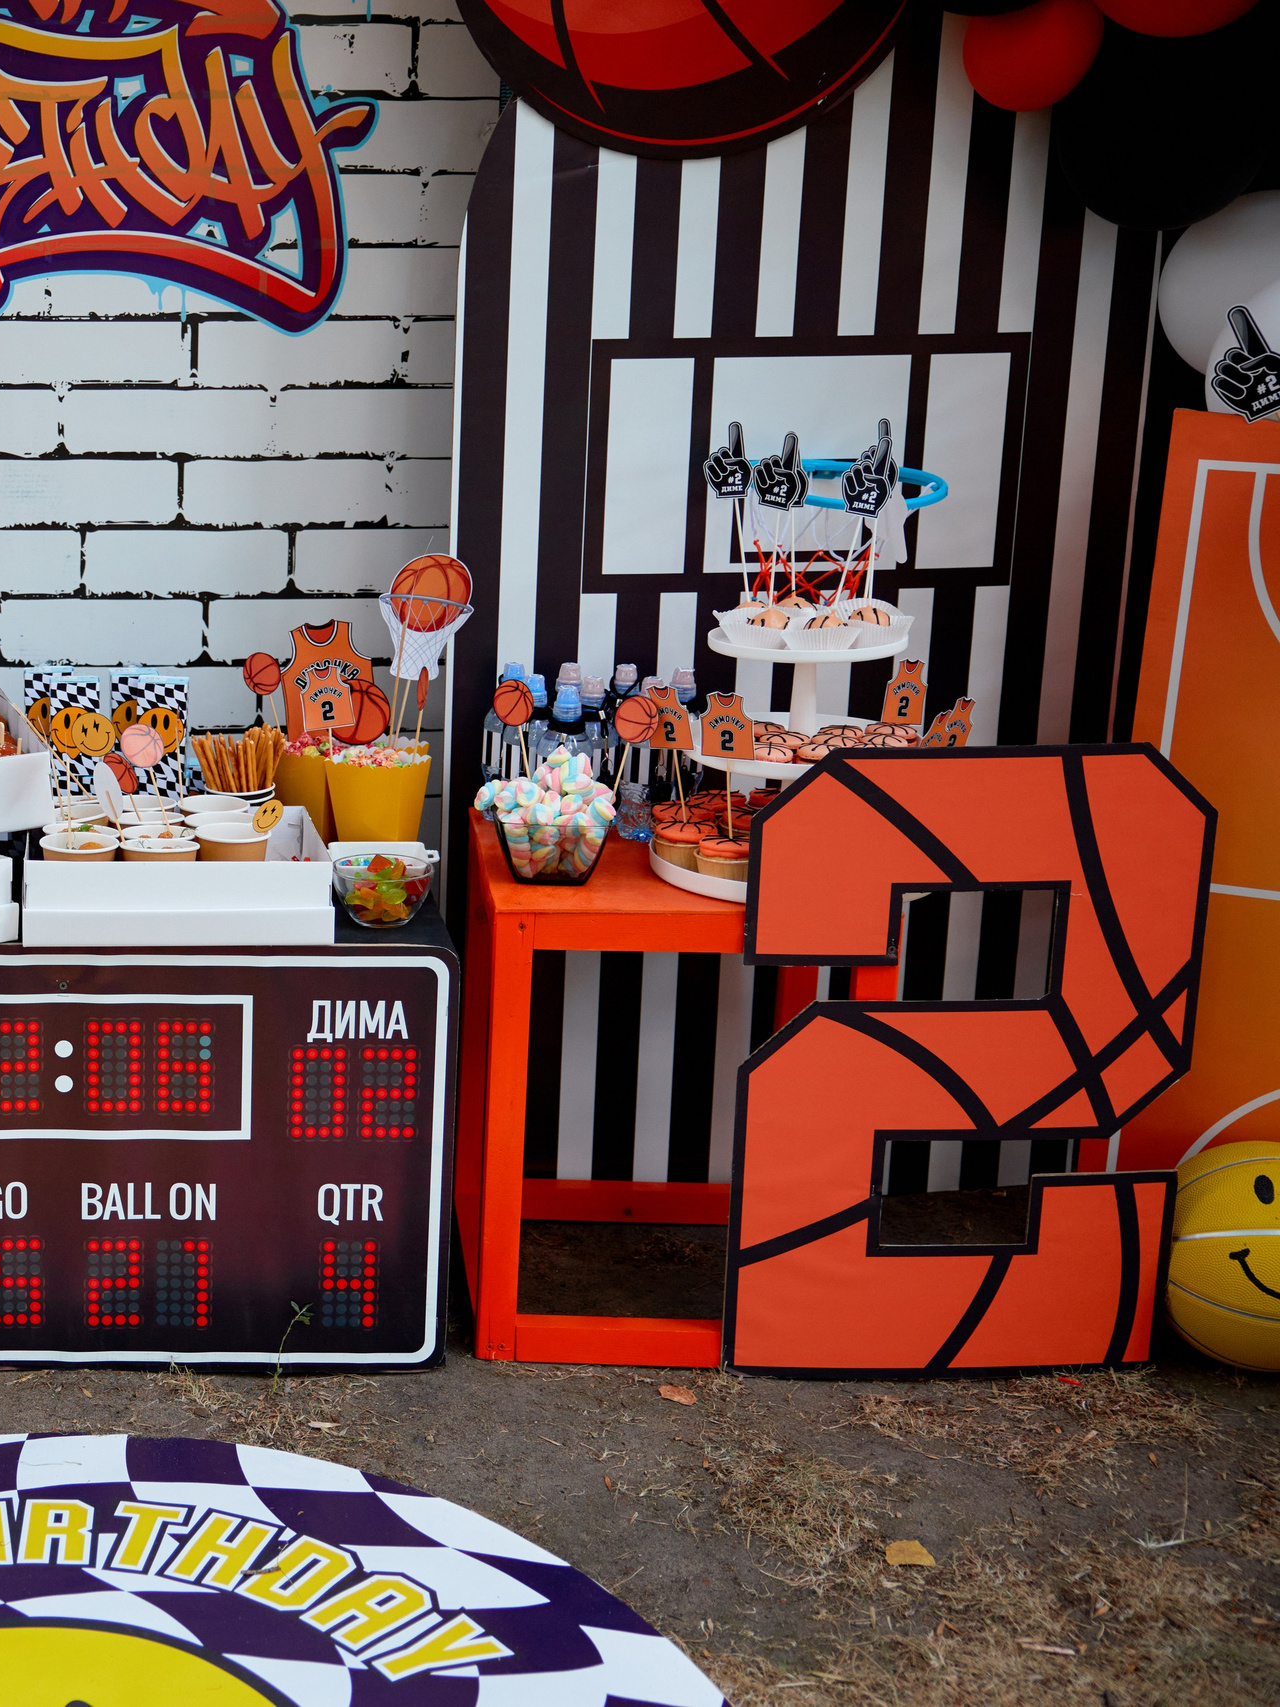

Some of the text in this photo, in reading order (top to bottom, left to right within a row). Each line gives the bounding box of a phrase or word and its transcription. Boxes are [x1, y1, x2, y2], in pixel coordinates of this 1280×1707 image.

[1257, 374, 1280, 396] #2
[1251, 392, 1280, 411] ДИМ
[721, 485, 743, 493] ДИМЕ
[728, 472, 743, 485] #2
[764, 493, 787, 504] ДИМЕ
[772, 484, 788, 497] #2
[861, 491, 877, 504] #2
[852, 501, 876, 511] ДИМЕ
[308, 686, 344, 705] ДИМОЧКА
[896, 695, 910, 718] 2
[320, 699, 336, 722] 2
[658, 706, 683, 721] МОЧКА
[663, 720, 677, 742] 2
[707, 714, 746, 731] ДИМОЧКА
[720, 729, 735, 752] 2
[306, 1000, 409, 1043] ДИМА
[719, 742, 1218, 1380] 2
[290, 1047, 417, 1138] 02
[80, 1182, 217, 1222] BALL ON
[317, 1183, 384, 1226] QTR
[86, 1239, 209, 1327] 21
[322, 1240, 377, 1327] 4
